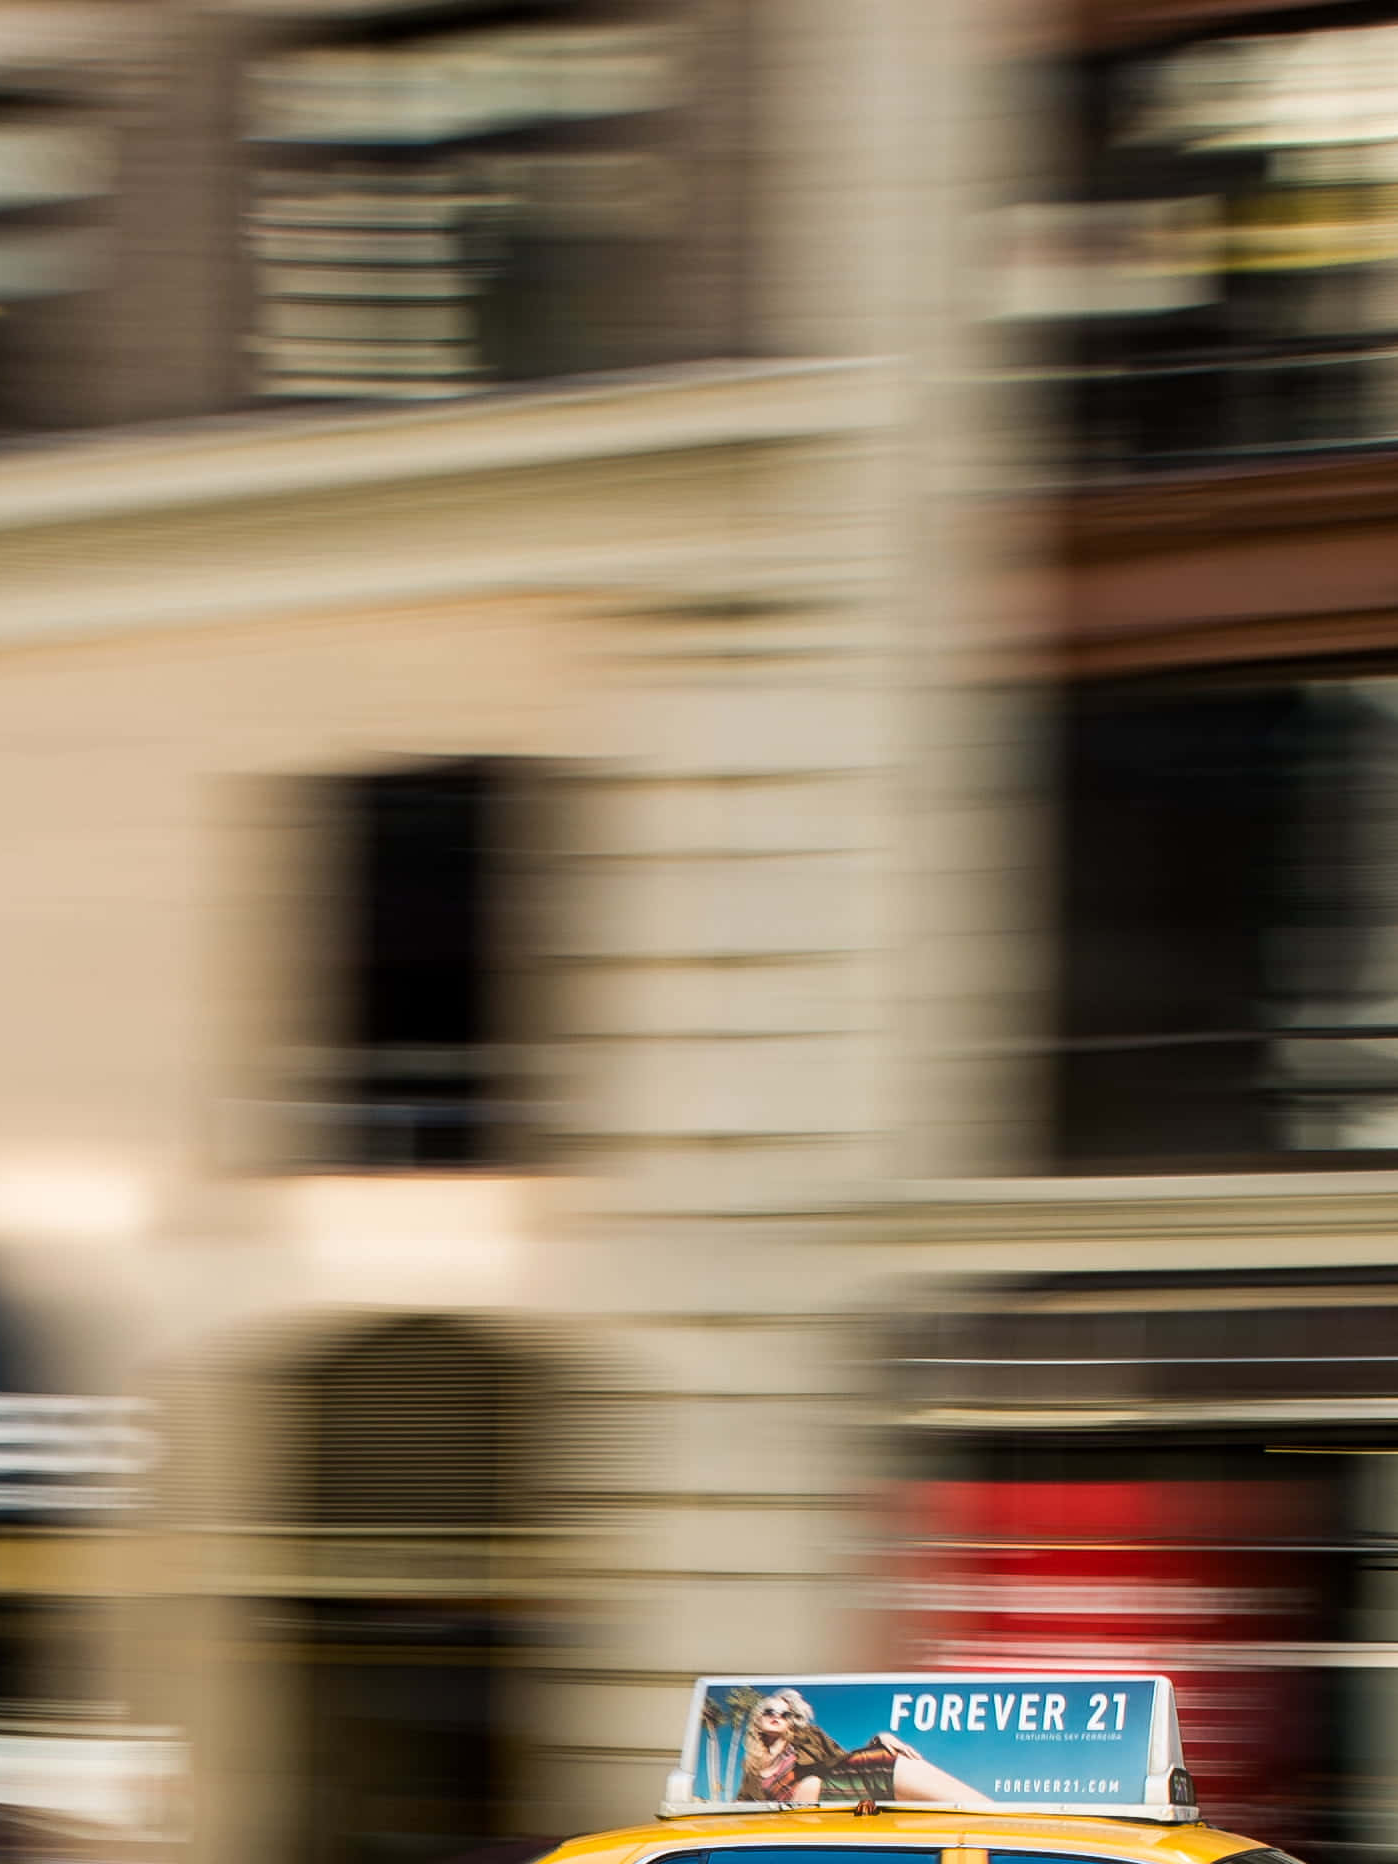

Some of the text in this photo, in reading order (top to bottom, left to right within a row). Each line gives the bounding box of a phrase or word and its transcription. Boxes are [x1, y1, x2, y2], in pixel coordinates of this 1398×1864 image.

[889, 1692, 1128, 1732] FOREVER 21
[994, 1779, 1121, 1793] FOREVER21.COM
